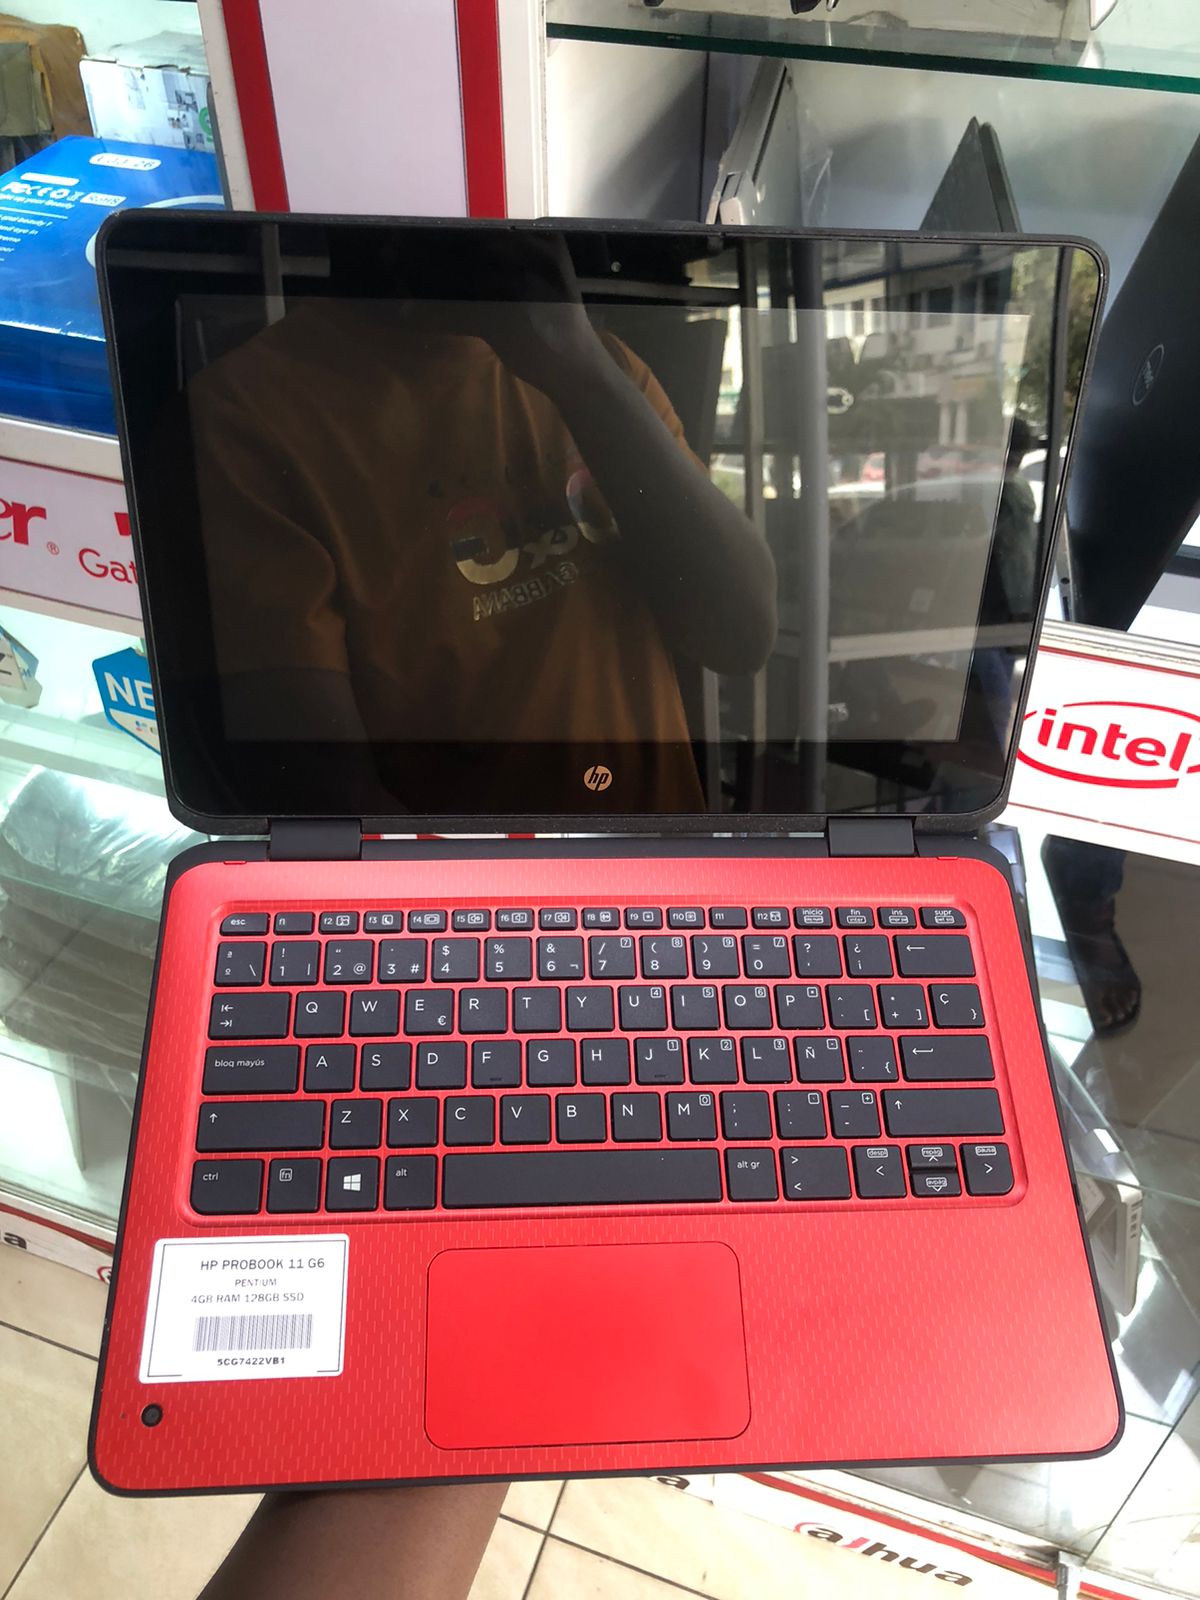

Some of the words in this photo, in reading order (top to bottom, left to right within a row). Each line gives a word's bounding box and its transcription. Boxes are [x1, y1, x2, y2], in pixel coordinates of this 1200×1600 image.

[1037, 708, 1192, 772] intel
[586, 765, 611, 791] hp
[802, 909, 823, 917] inicio
[848, 909, 862, 917] fin
[890, 909, 905, 917] ins
[935, 910, 954, 918] supr
[442, 945, 450, 956] $
[494, 944, 504, 953] %
[547, 943, 555, 953] &
[804, 943, 811, 952] ?
[333, 965, 341, 975] 2
[353, 963, 366, 975] @
[387, 964, 395, 974] 3
[411, 964, 419, 973] #
[441, 963, 449, 973] 4
[496, 962, 503, 972] 5
[547, 961, 556, 971] 6
[599, 960, 606, 970] 7
[651, 960, 659, 970] 8
[703, 960, 711, 970] 9
[280, 966, 284, 976] 1
[415, 999, 424, 1011] E
[469, 998, 479, 1010] R
[522, 997, 531, 1008] T
[577, 996, 587, 1007] Y
[629, 996, 639, 1007] U
[682, 995, 685, 1007] I
[735, 995, 746, 1006] O
[786, 995, 795, 1006] P
[306, 1002, 318, 1013] Q
[362, 1001, 377, 1012] W
[438, 1015, 446, 1025] €
[482, 1052, 491, 1063] F
[538, 1050, 548, 1062] G
[592, 1049, 601, 1061] H
[645, 1049, 652, 1060] J
[699, 1048, 709, 1060] K
[753, 1048, 762, 1059] L
[806, 1047, 815, 1058] Ñ
[237, 1059, 264, 1067] mayús
[316, 1056, 327, 1067] A
[372, 1054, 380, 1066] S
[428, 1053, 438, 1064] D
[399, 1109, 408, 1121] X
[455, 1107, 465, 1120] C
[511, 1106, 522, 1118] V
[567, 1105, 577, 1117] B
[623, 1104, 633, 1116] N
[678, 1104, 690, 1115] M
[341, 1111, 351, 1123] Z
[281, 1170, 291, 1180] fn
[396, 1168, 407, 1176] alt
[201, 1260, 218, 1270] HP
[222, 1259, 283, 1270] PROBOOK
[289, 1259, 304, 1269] 11
[308, 1258, 324, 1268] G6
[235, 1279, 276, 1287] PENTIUM
[191, 1295, 212, 1303] 4GB
[217, 1294, 240, 1302] RAM
[246, 1293, 279, 1302] 128GB
[283, 1293, 304, 1301] SSD
